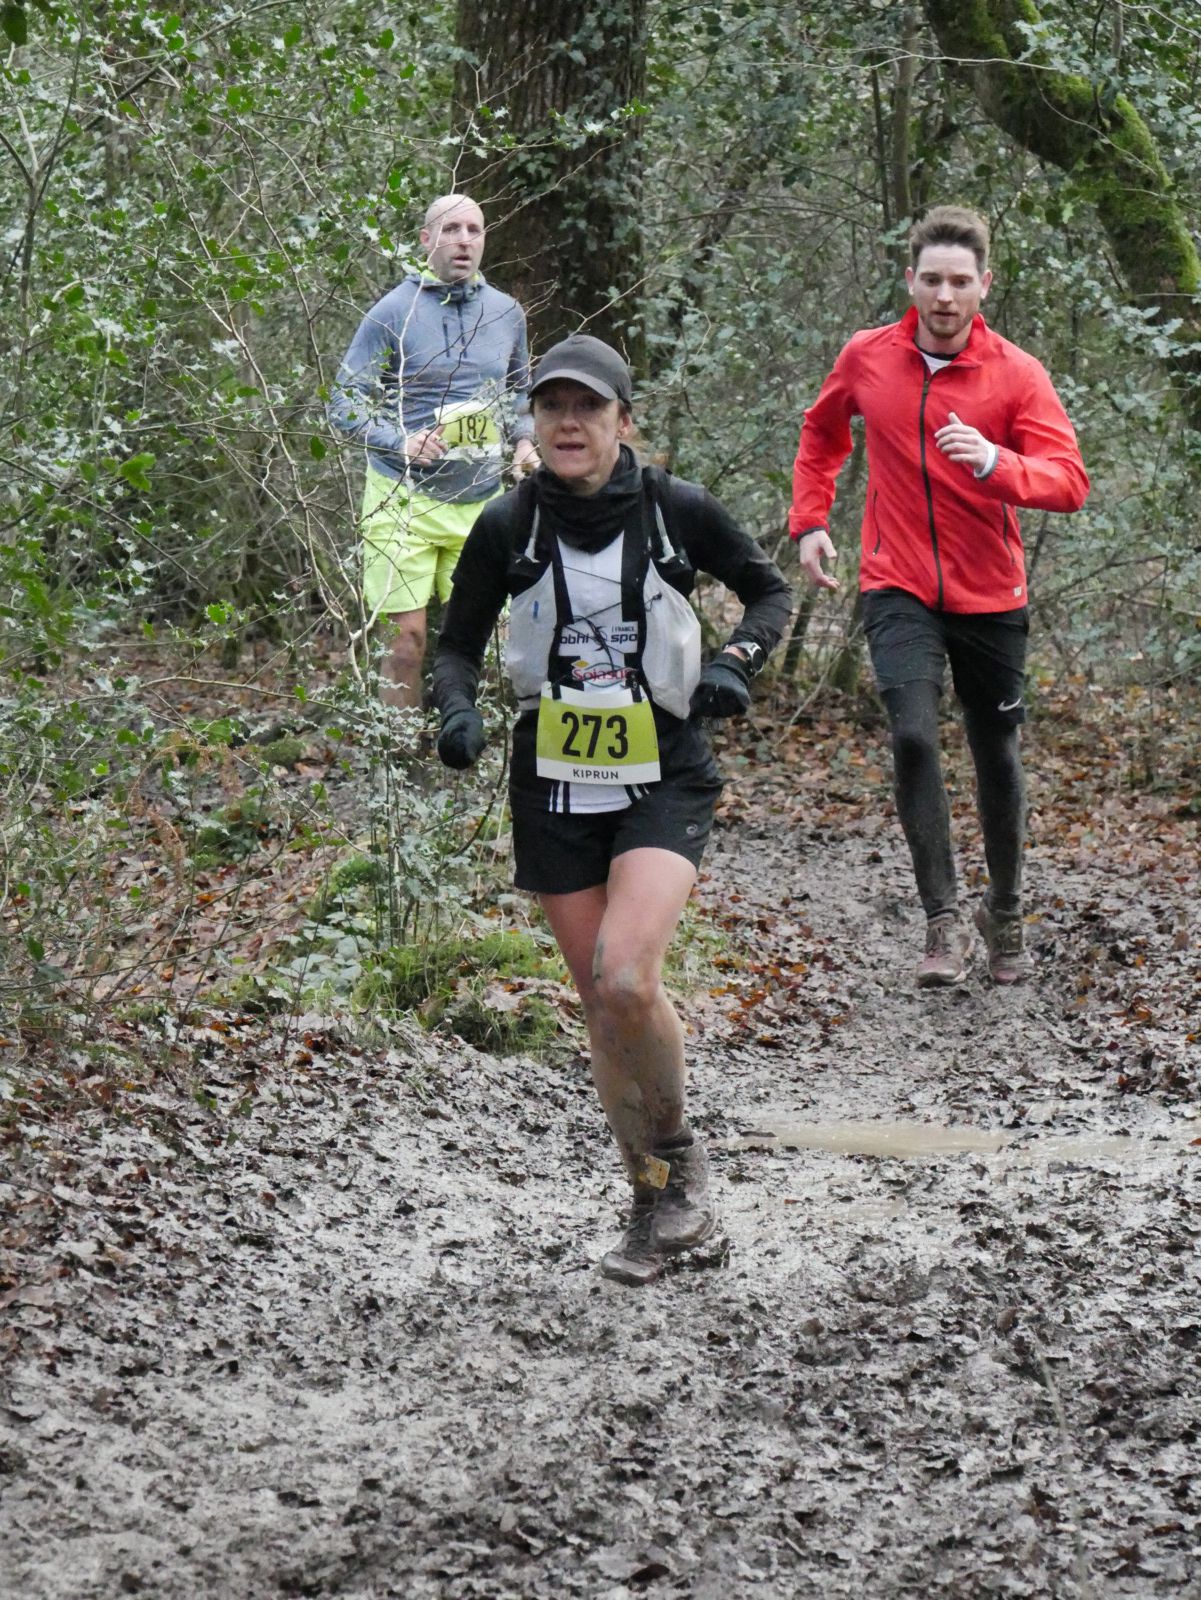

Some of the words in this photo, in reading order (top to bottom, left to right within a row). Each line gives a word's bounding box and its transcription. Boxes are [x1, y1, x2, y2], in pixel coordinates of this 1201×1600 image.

[459, 416, 487, 444] 182
[561, 711, 629, 759] 273
[572, 768, 619, 779] KIPRUN
